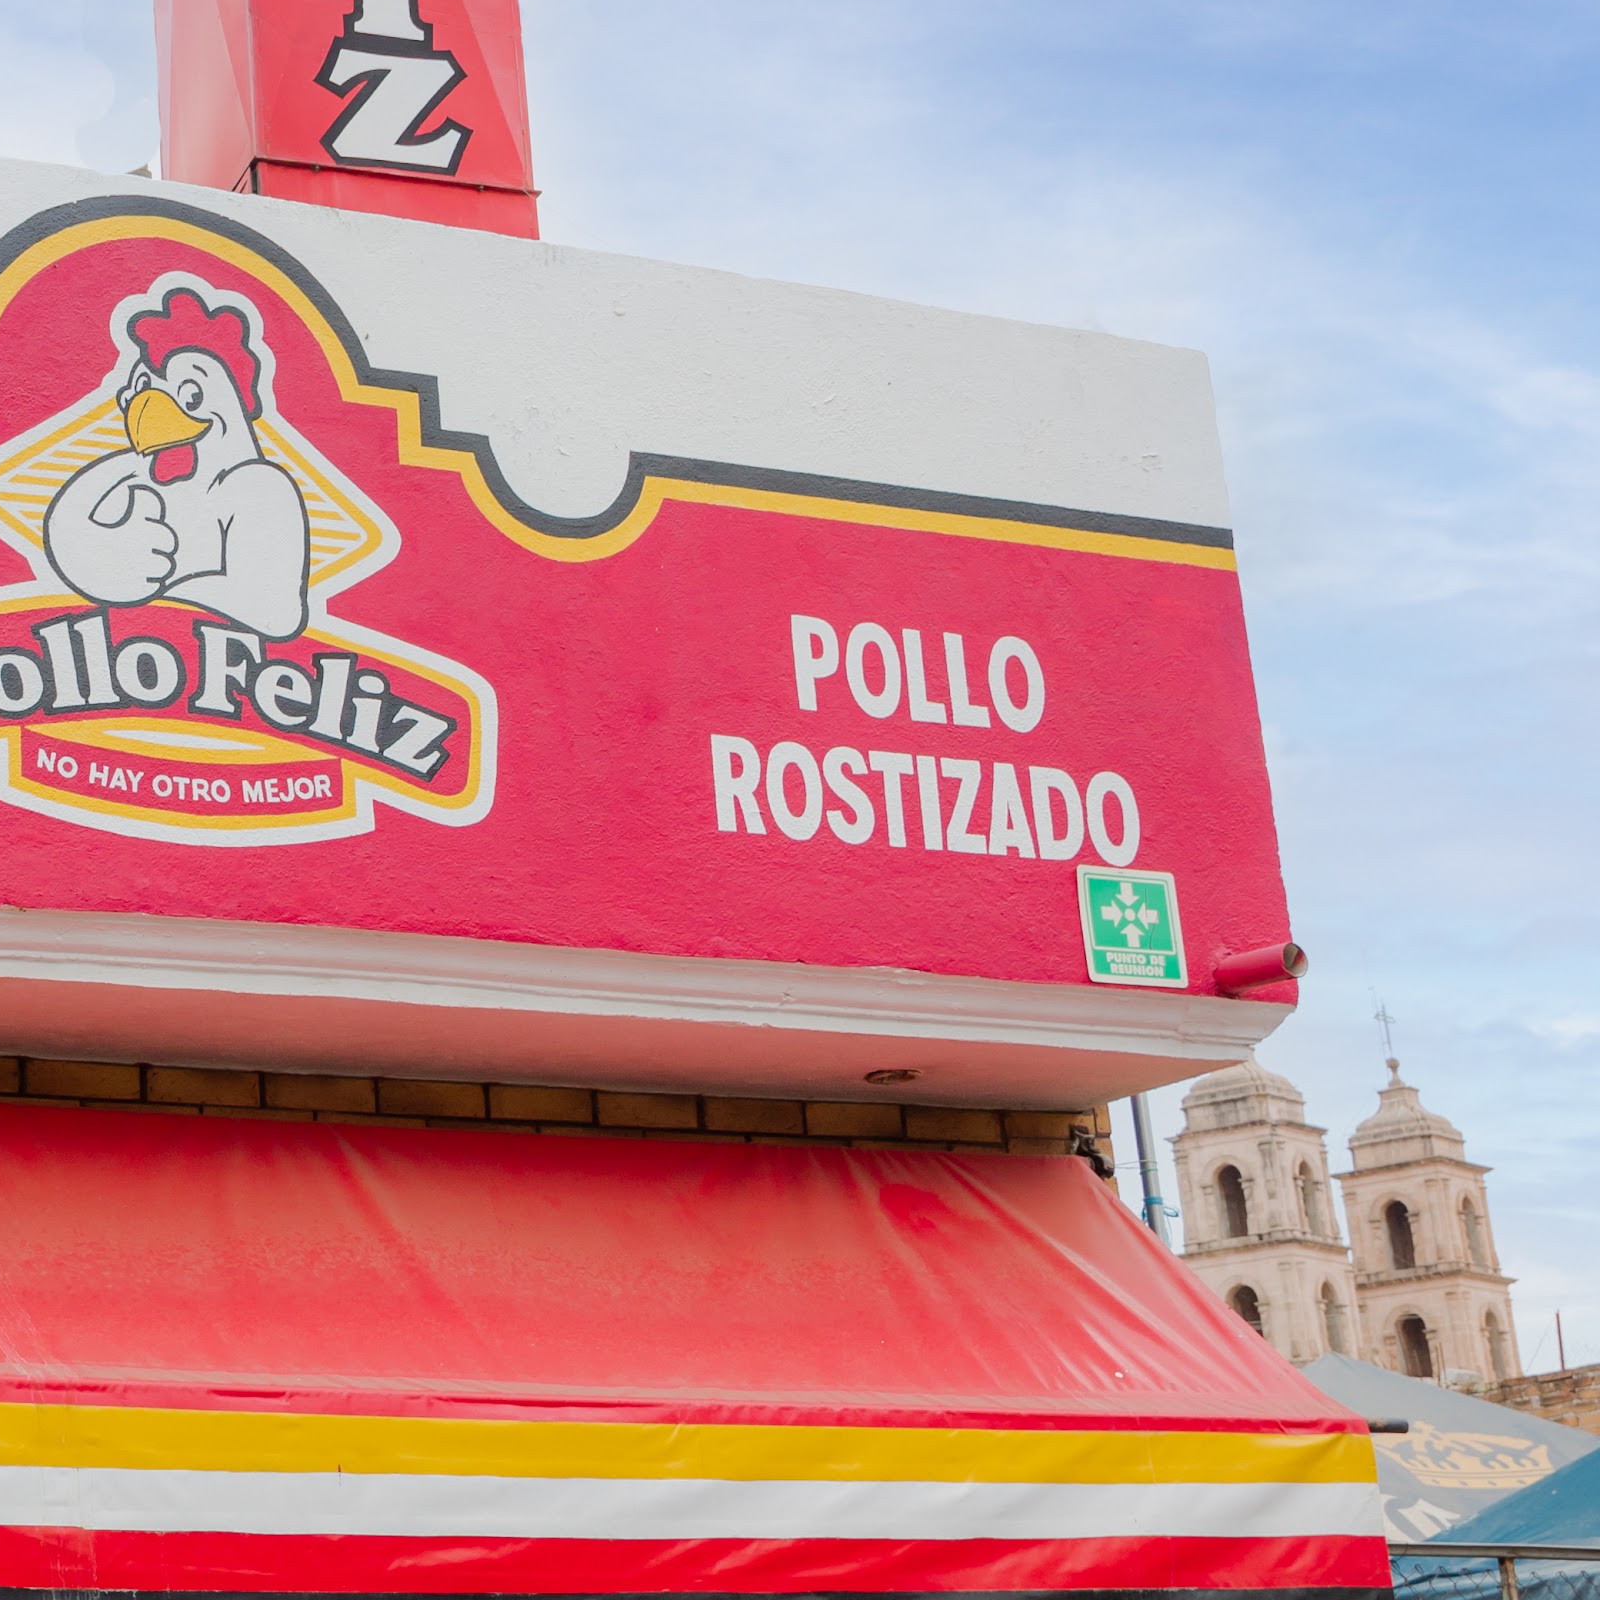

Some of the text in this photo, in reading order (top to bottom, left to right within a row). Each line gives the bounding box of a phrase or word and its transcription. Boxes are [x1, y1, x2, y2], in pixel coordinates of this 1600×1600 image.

[188, 619, 458, 782] Feliz
[790, 613, 1046, 734] POLLO
[36, 747, 333, 804] NO HAY OTRO MEJOR
[710, 733, 1141, 868] ROSTIZADO
[1105, 951, 1166, 966] PUNTO DE
